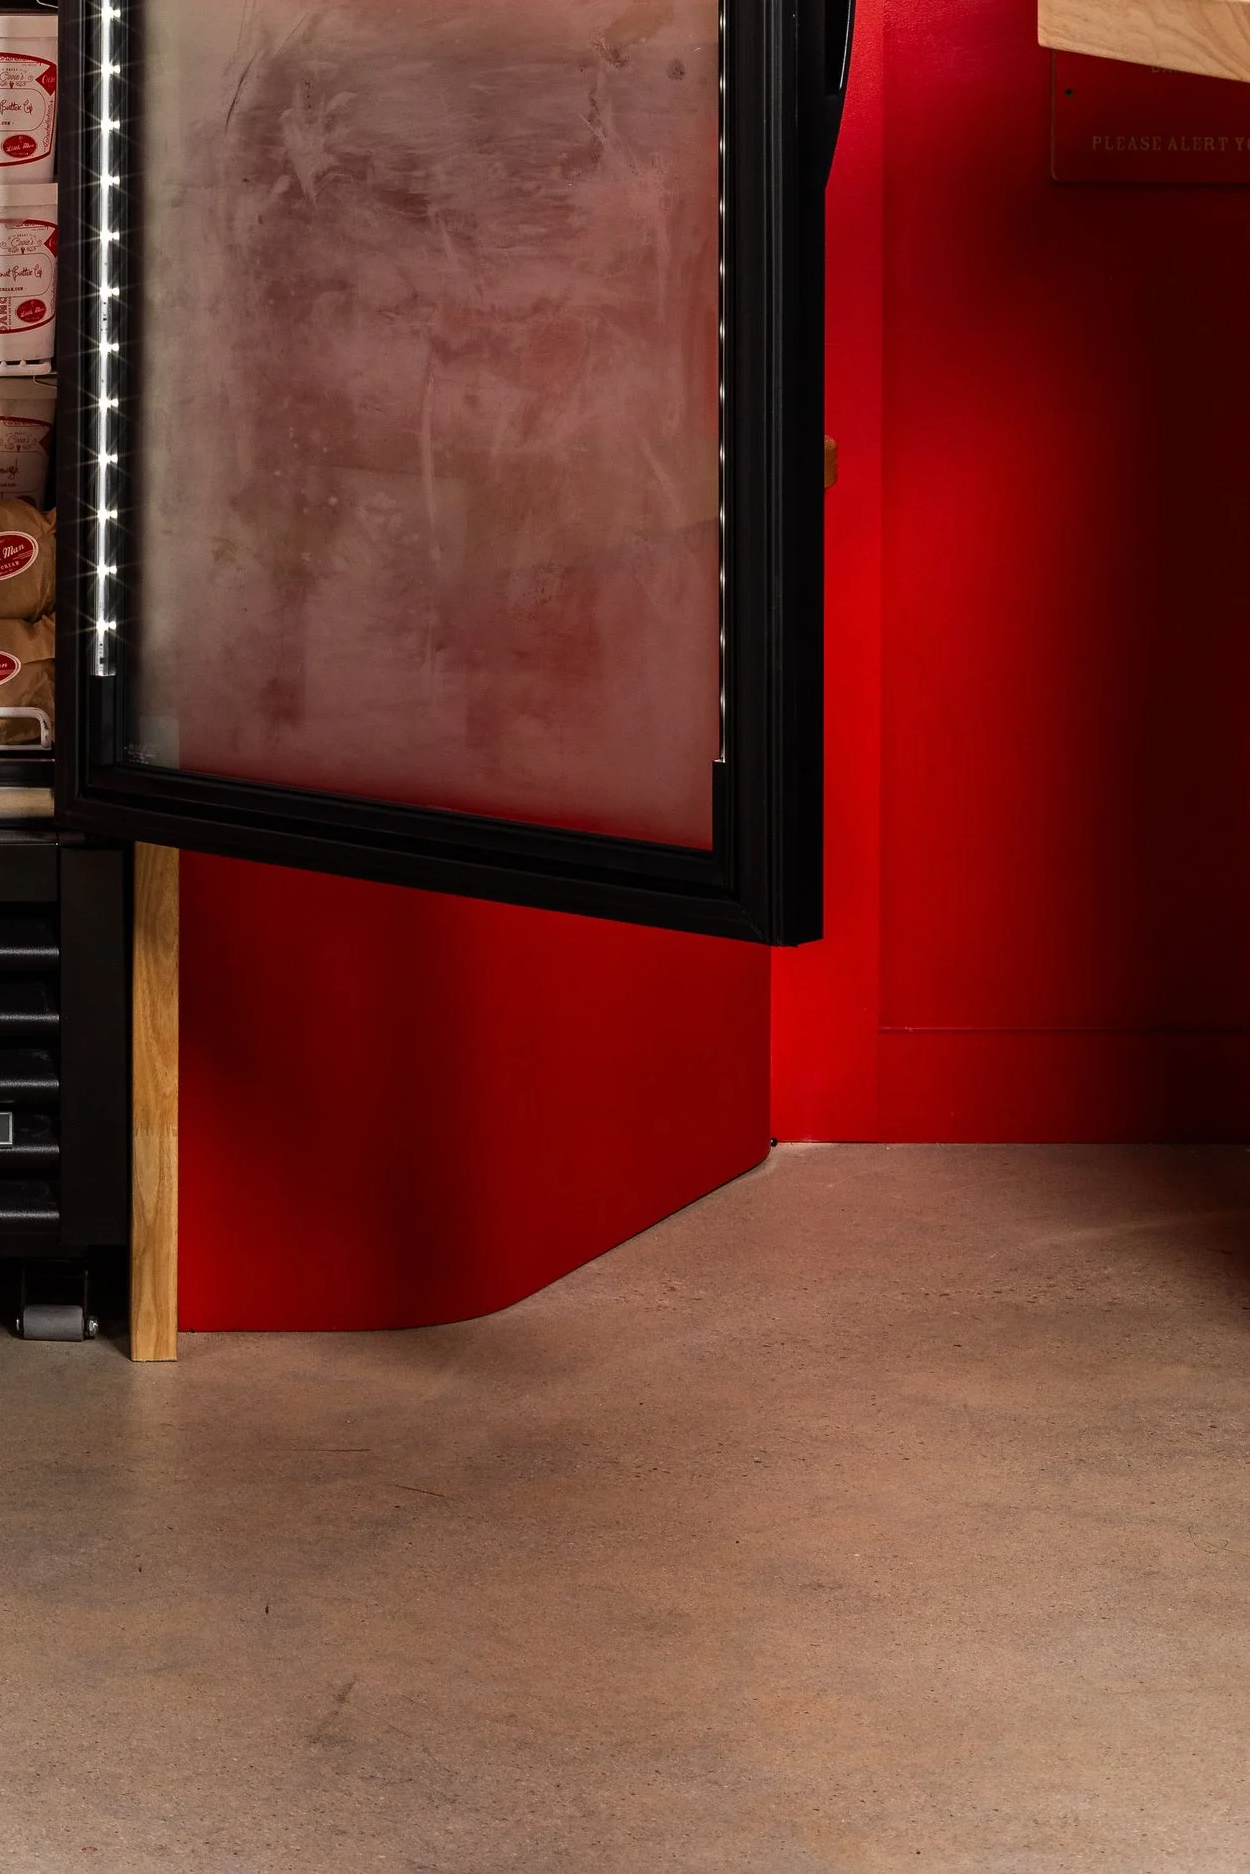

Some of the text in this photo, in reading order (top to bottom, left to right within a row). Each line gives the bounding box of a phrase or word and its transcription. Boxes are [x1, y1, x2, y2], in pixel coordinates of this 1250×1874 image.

[1091, 135, 1162, 151] PLEASE
[1168, 135, 1229, 152] ALERT
[3, 543, 25, 559] Man
